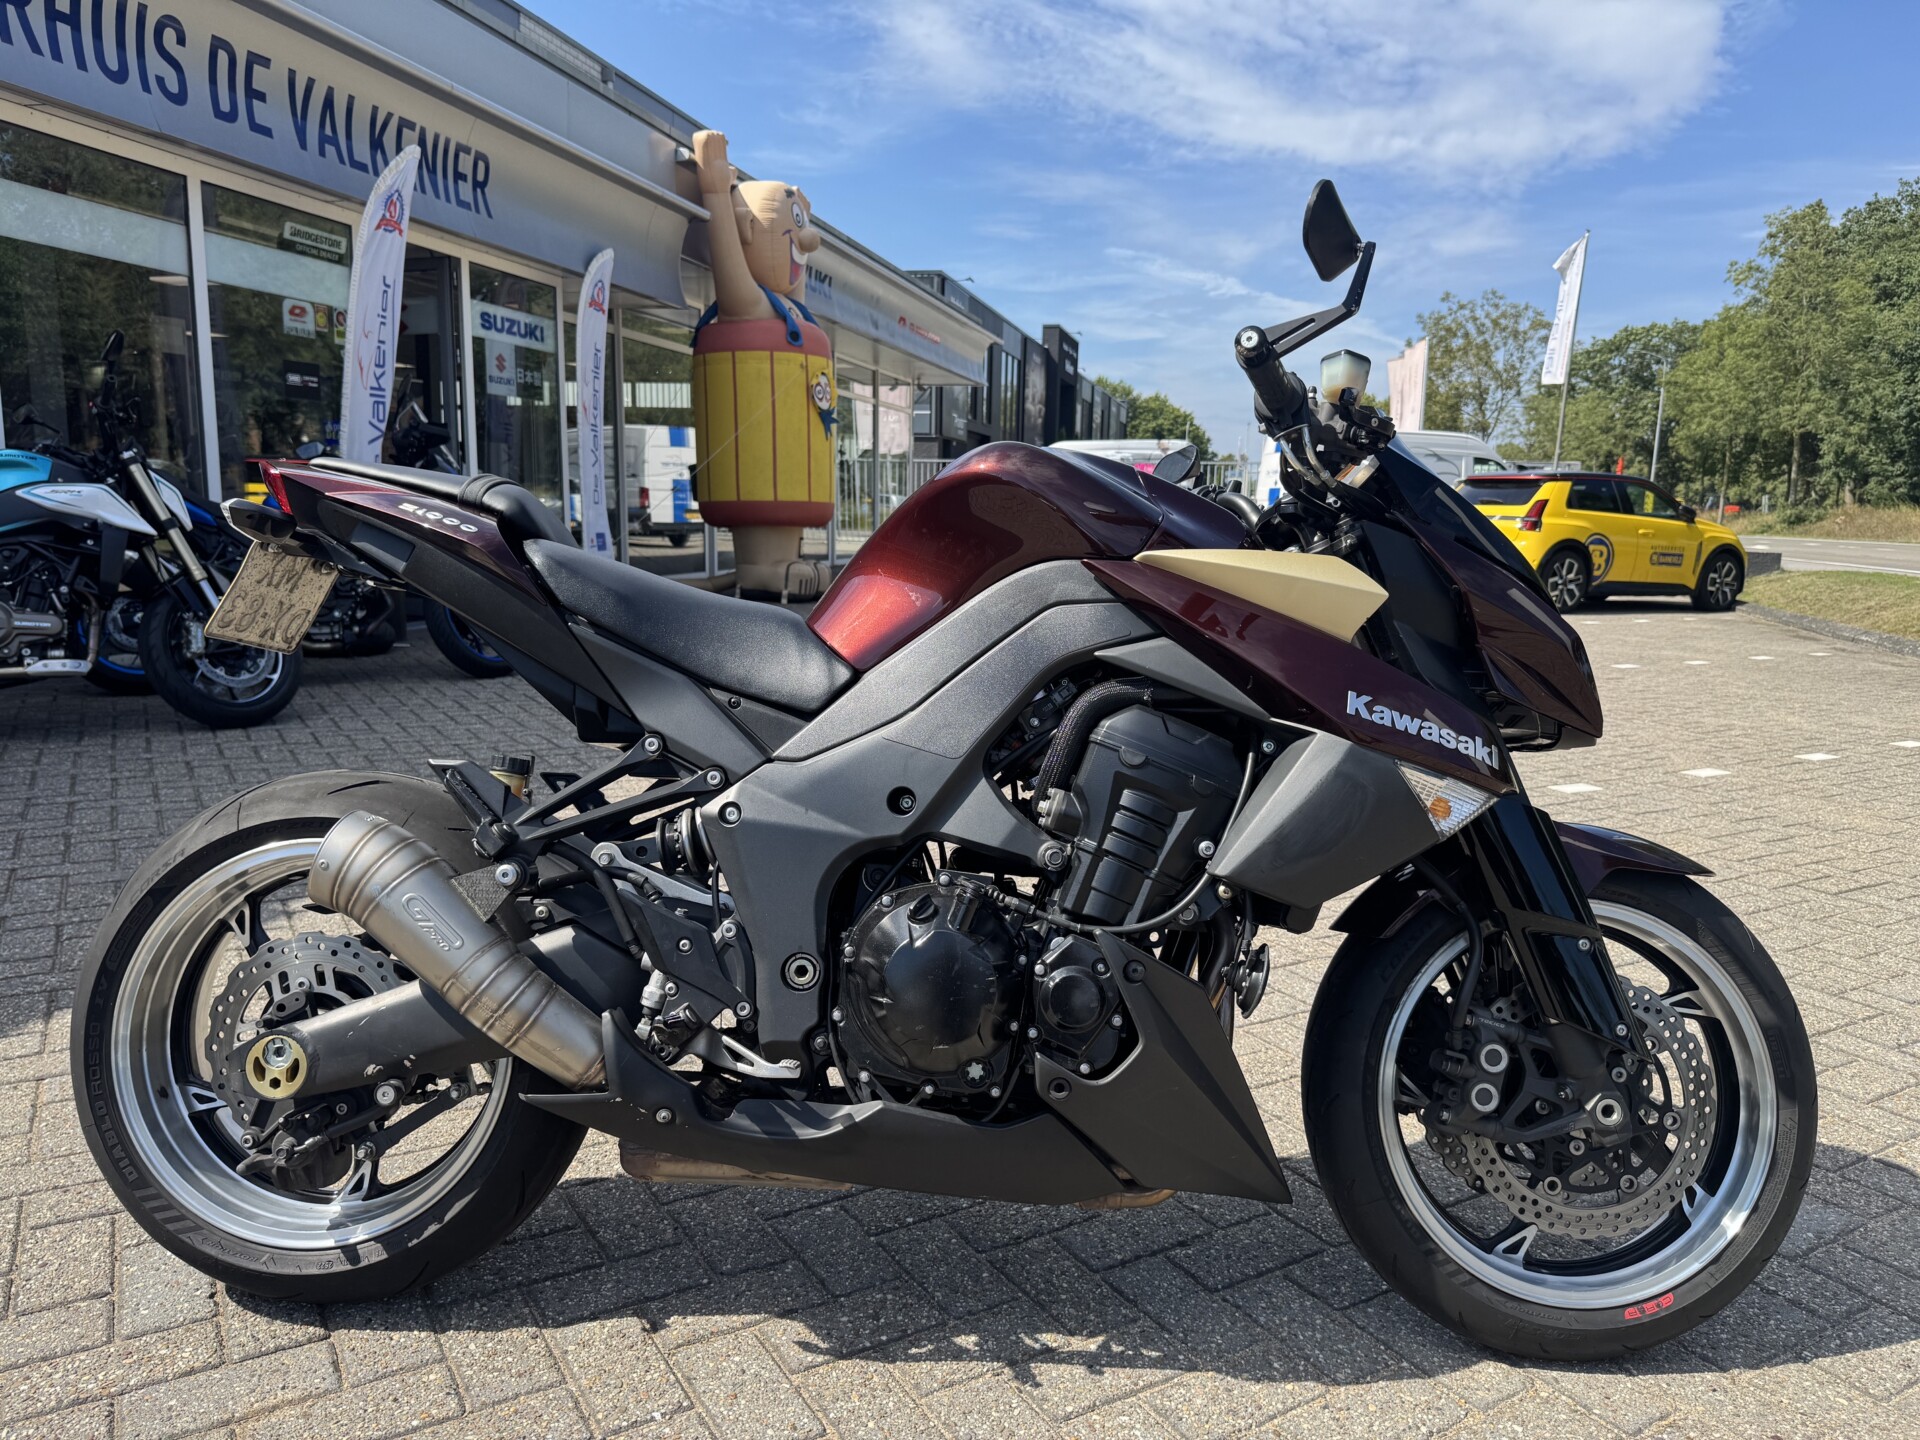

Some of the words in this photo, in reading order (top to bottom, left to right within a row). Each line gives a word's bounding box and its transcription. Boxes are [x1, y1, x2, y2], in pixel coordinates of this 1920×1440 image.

[208, 34, 274, 139] DE
[289, 226, 343, 250] BRIDGESTONE
[804, 264, 832, 300] UKI
[480, 311, 544, 343] SUZUKI
[367, 276, 393, 445] Valkenier
[488, 374, 515, 387] SUZUKI
[591, 341, 602, 468] Valkenier
[398, 502, 479, 533] Z1000
[1346, 690, 1499, 770] Kawasaki
[1479, 1017, 1506, 1029] TOKICO
[88, 1021, 103, 1097] ROSSO
[94, 1102, 139, 1184] DIABLO
